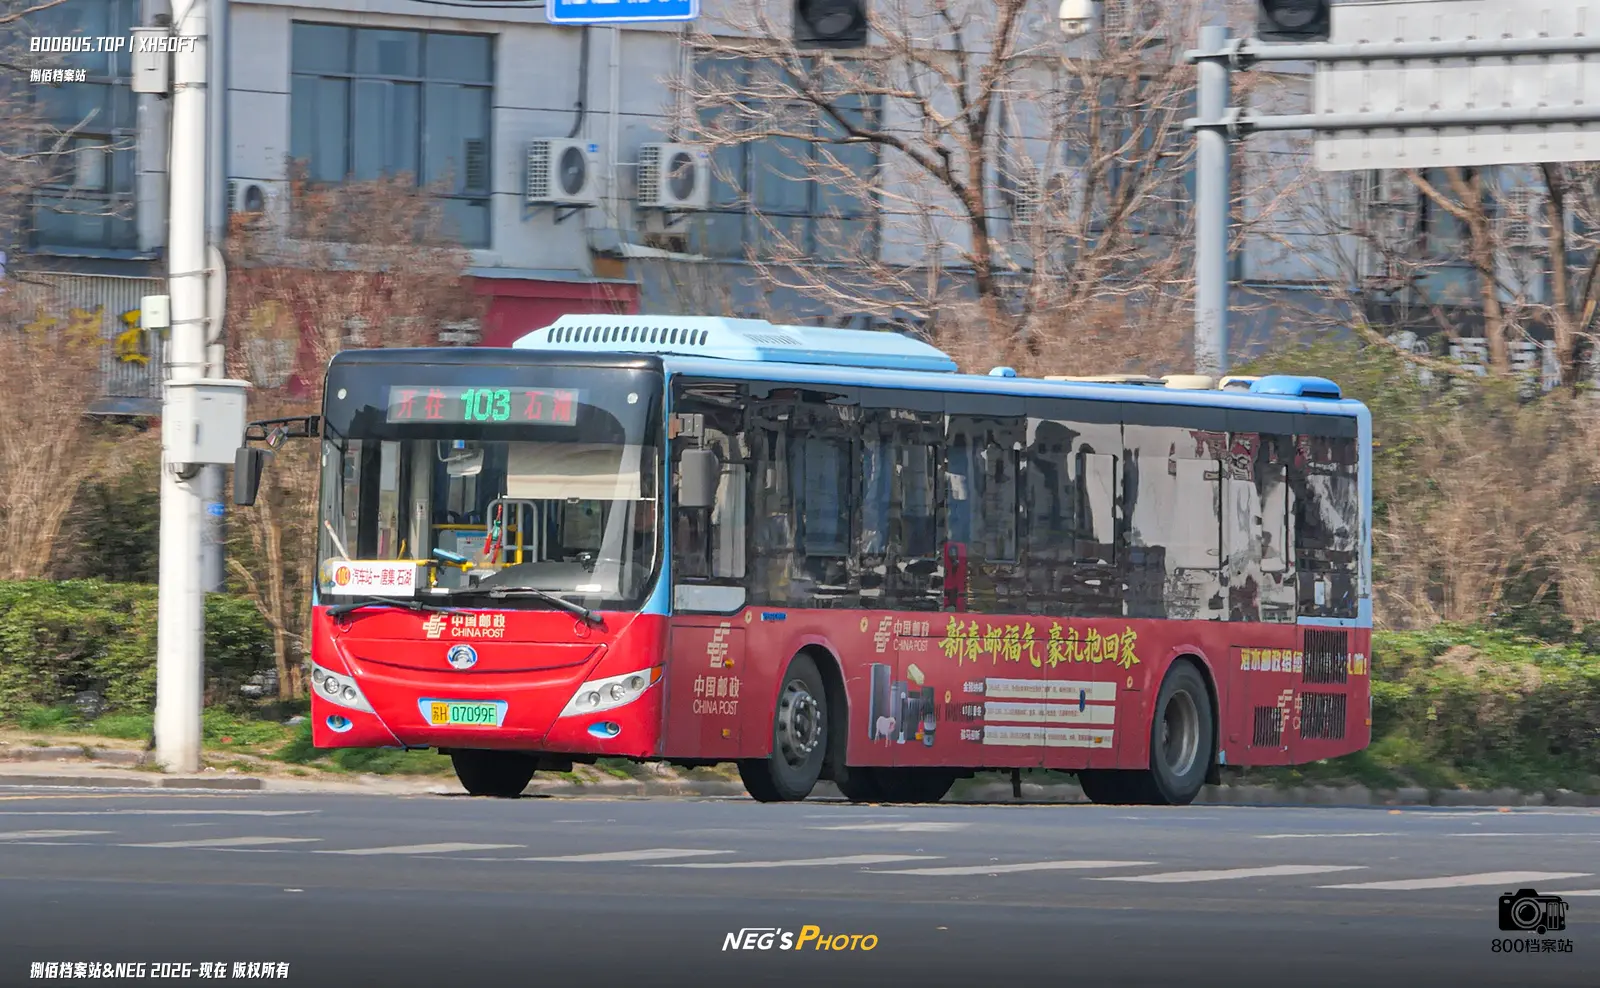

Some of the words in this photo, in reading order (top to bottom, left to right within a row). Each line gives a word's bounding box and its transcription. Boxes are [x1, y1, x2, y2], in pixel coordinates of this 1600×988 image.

[460, 388, 511, 421] 103
[451, 612, 506, 628] 中国邮政
[893, 619, 930, 637] 中国邮政
[451, 627, 481, 638] CHINA
[482, 628, 505, 638] POST
[893, 638, 914, 651] CHINA
[914, 639, 928, 652] POST
[938, 615, 1042, 668] 新春邮福气
[1046, 621, 1141, 669] 豪礼抱回家
[693, 674, 740, 698] 中国邮政
[452, 706, 495, 722] 07099F
[693, 699, 718, 715] CHINA
[719, 700, 739, 716] POST
